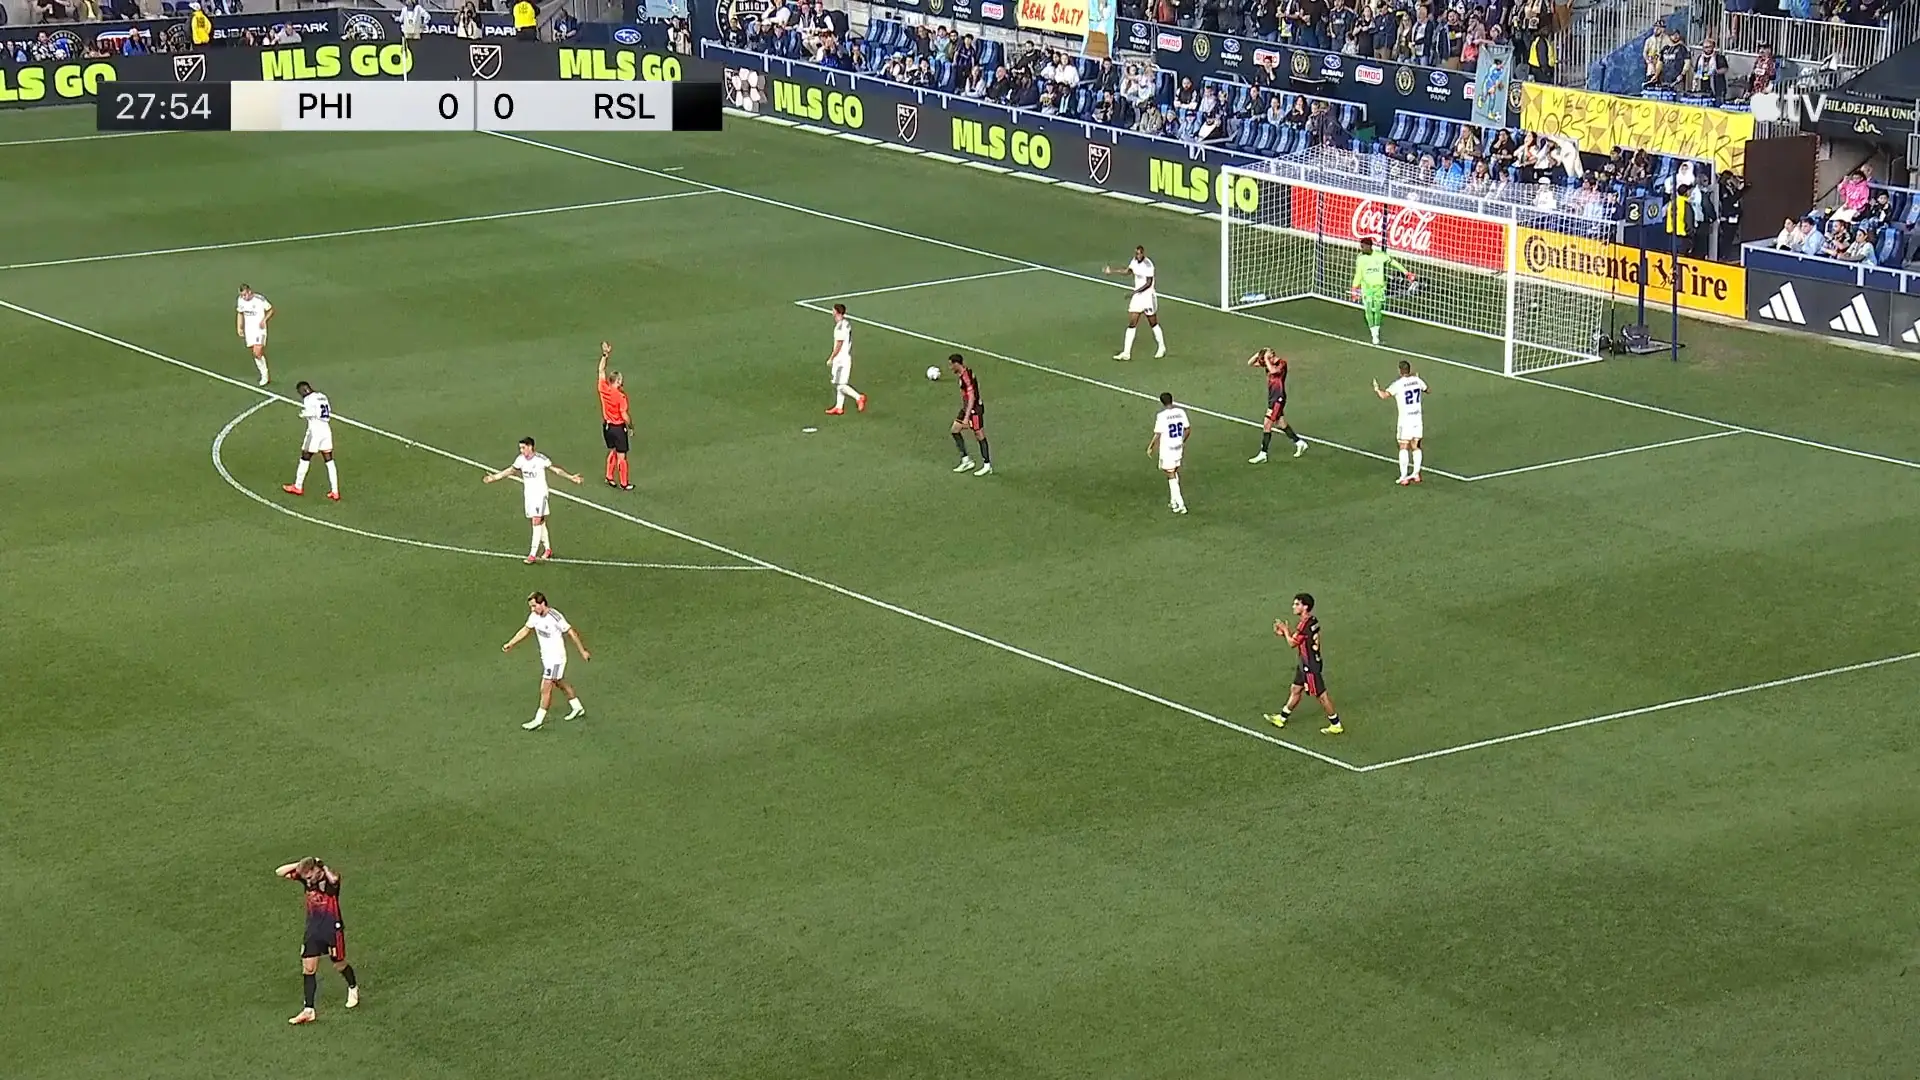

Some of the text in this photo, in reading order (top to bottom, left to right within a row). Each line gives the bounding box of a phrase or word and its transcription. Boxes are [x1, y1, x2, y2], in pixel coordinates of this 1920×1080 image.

[1022, 0, 1083, 26] REAL SALTY
[472, 48, 490, 56] MLS
[1129, 36, 1150, 46] SUBARU
[1220, 52, 1243, 62] SUBARU
[262, 45, 413, 81] MLS GO
[559, 49, 682, 81] MLS GO
[1320, 68, 1344, 78] SUBARU
[55, 63, 117, 97] GO
[1426, 85, 1451, 96] SUBARU
[774, 80, 864, 128] MLS GO
[1552, 92, 1702, 125] WELCOME TO YOUR
[1824, 99, 1890, 118] HILADELPHIA
[952, 117, 1051, 169] MLS GO
[1524, 105, 1600, 149] WORST
[1150, 158, 1259, 212] MLS GO
[1352, 200, 1436, 252] Coca-Cola
[1524, 234, 1728, 301] Continental Tire
[1404, 388, 1421, 405] 27
[1168, 421, 1183, 438] 26
